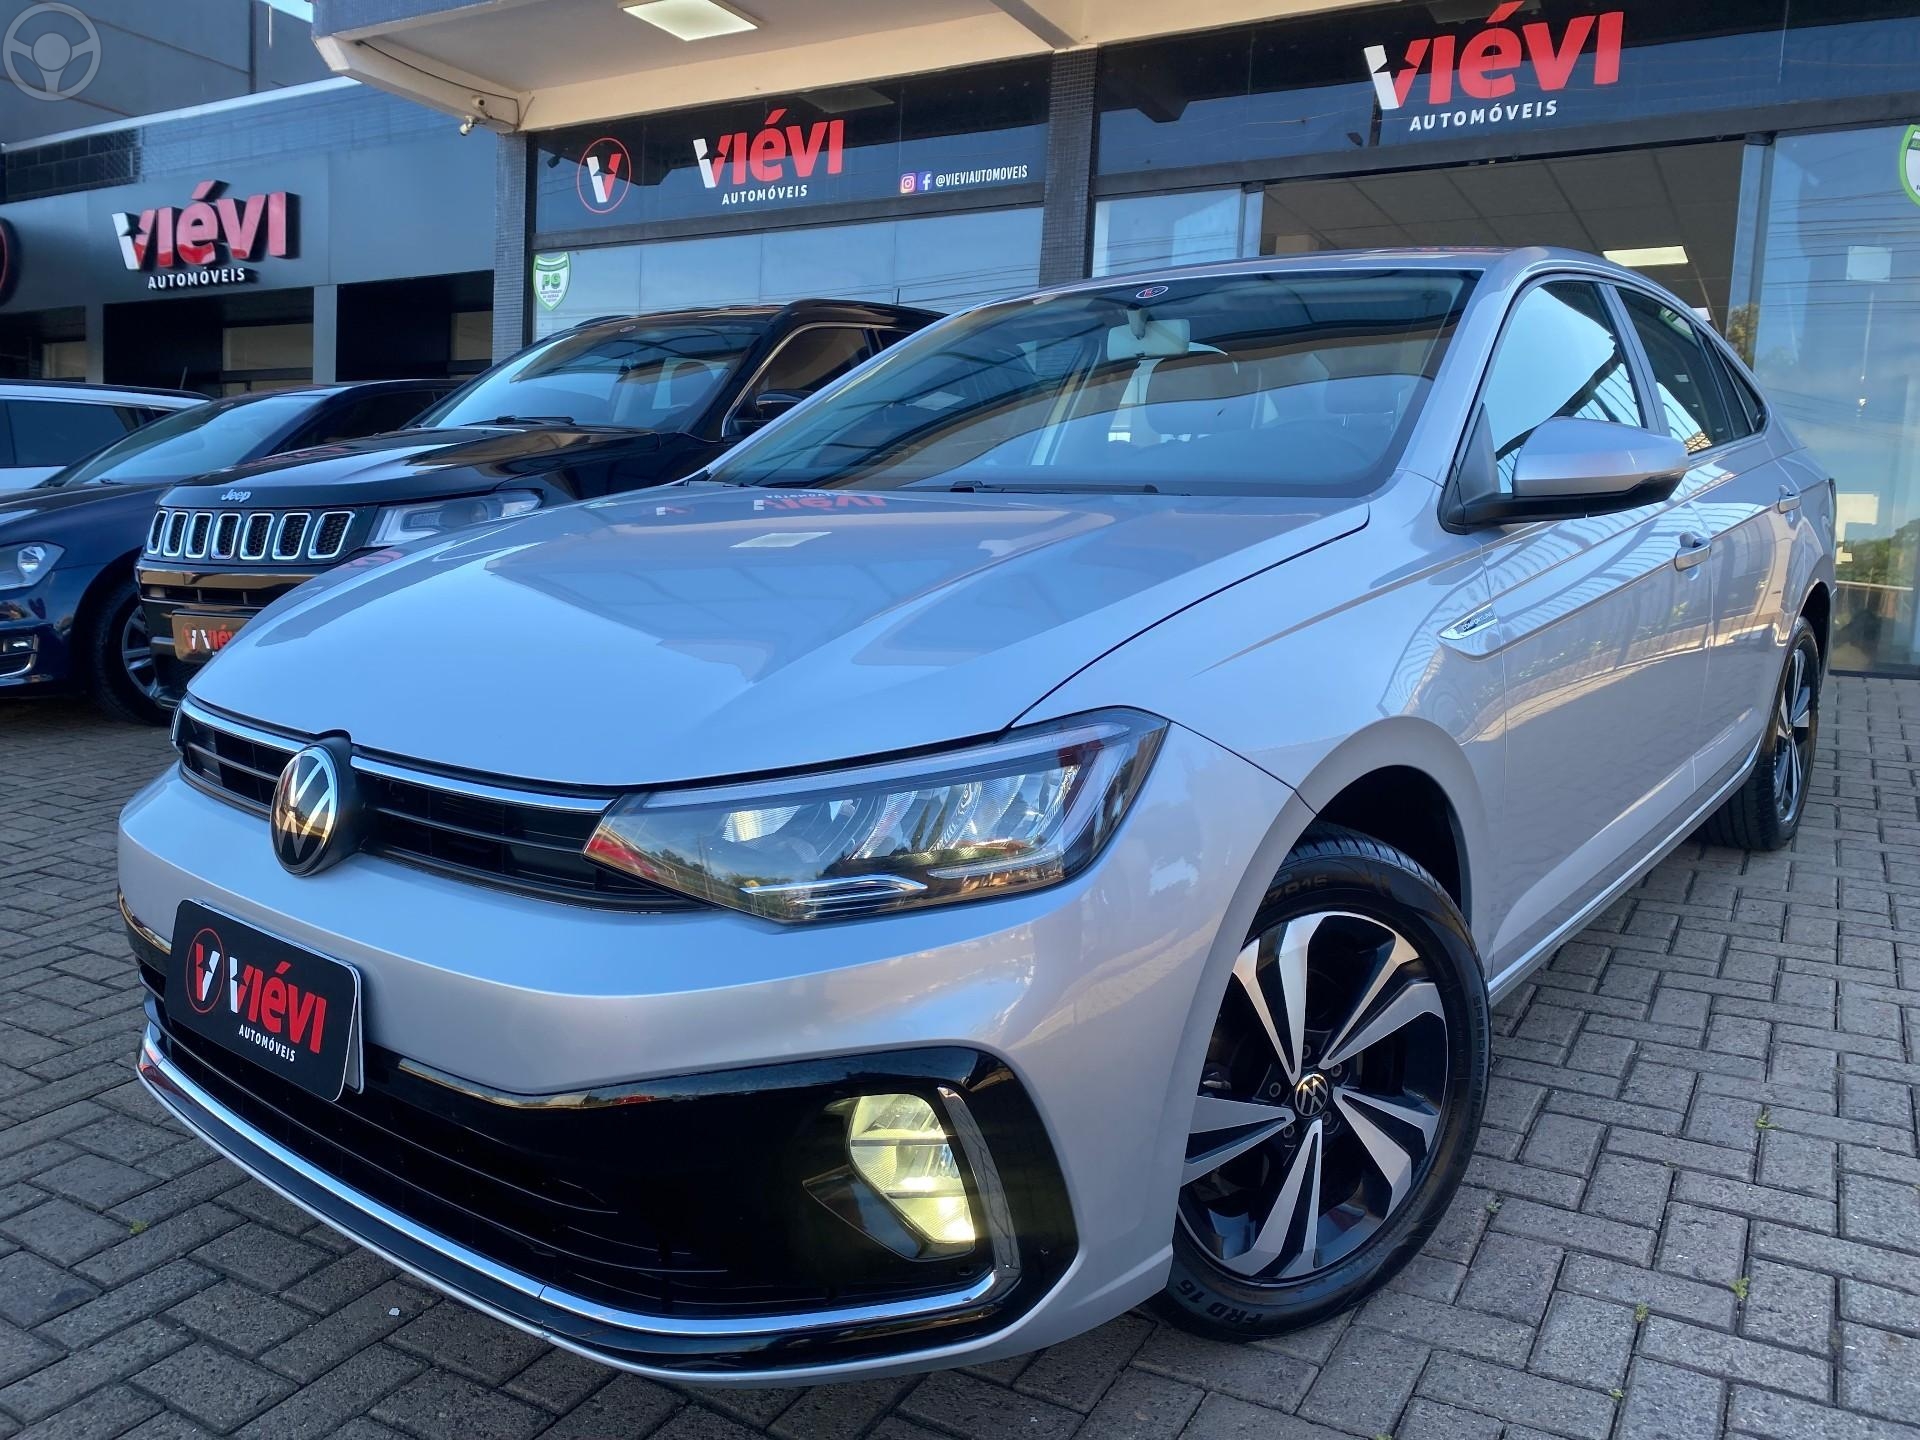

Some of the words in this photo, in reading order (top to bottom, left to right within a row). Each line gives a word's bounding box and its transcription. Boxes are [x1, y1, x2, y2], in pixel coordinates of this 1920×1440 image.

[1409, 101, 1557, 131] AUTOMÓVEIS
[936, 165, 1027, 187] @VIEVIAUTOMOVEIS
[722, 185, 808, 205] AUTOMÓVEIS
[148, 267, 245, 288] AUTOMÓVEIS
[221, 489, 251, 502] Jeep
[238, 1024, 296, 1062] AUTOMÓVEIS
